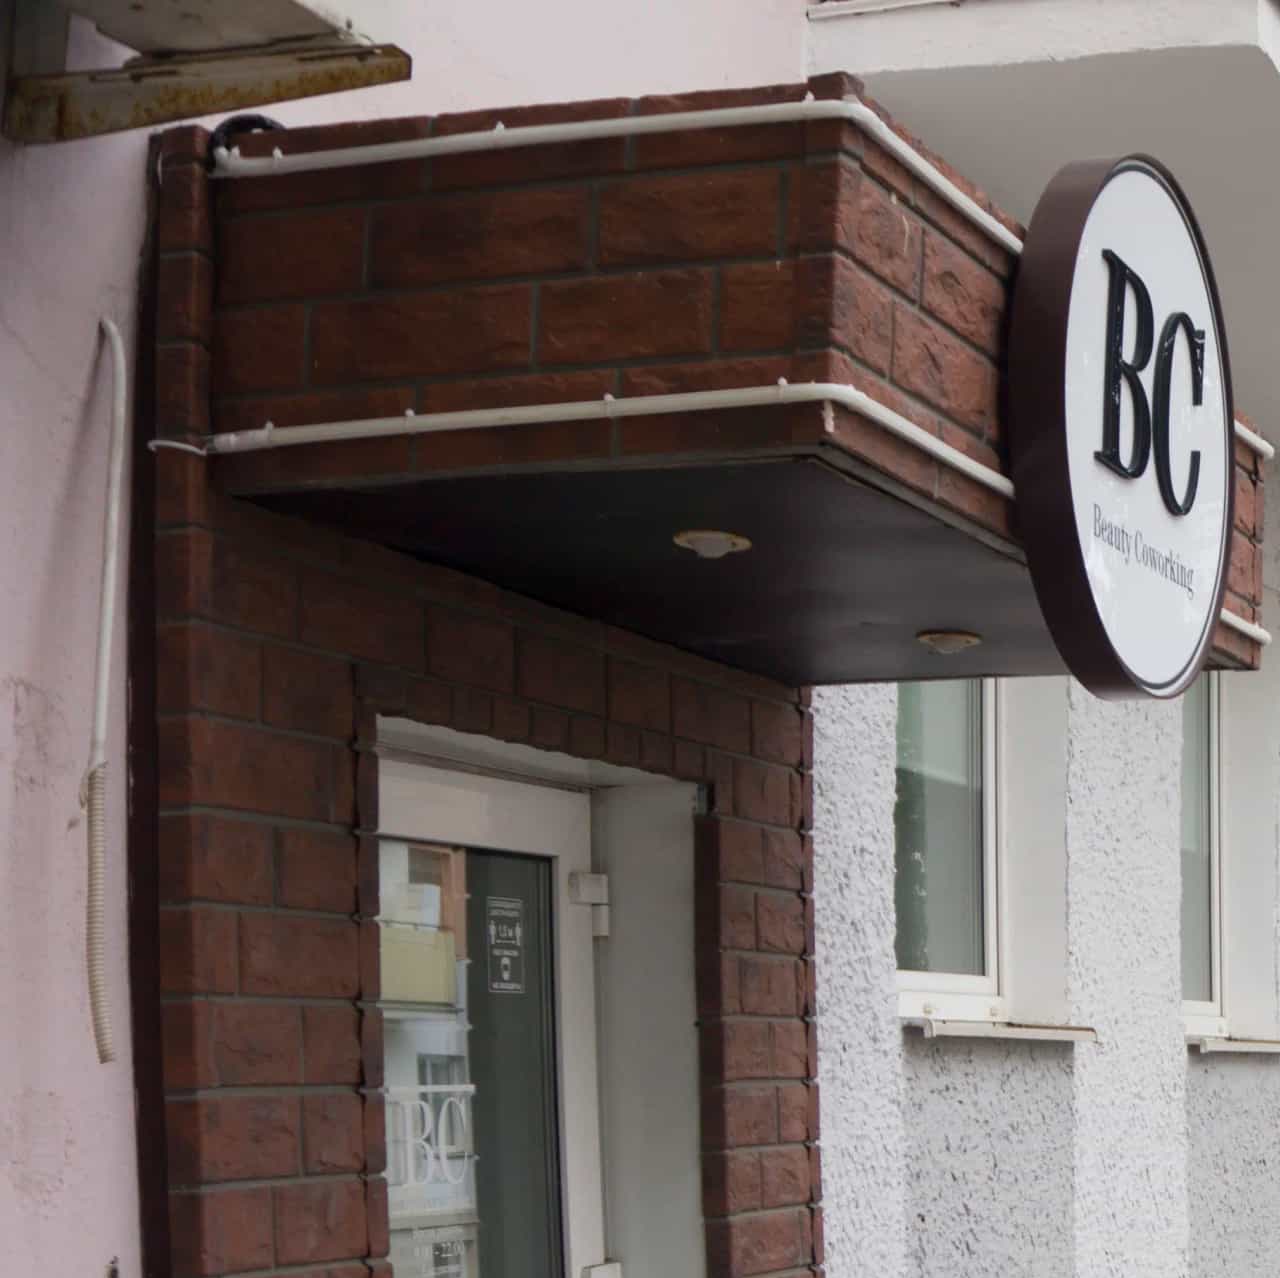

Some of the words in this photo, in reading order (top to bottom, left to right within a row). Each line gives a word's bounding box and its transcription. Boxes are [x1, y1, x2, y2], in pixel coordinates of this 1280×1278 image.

[1094, 248, 1206, 516] BC
[1093, 503, 1130, 566] Beauty
[1134, 530, 1195, 601] Coworking
[401, 1097, 469, 1186] BC
